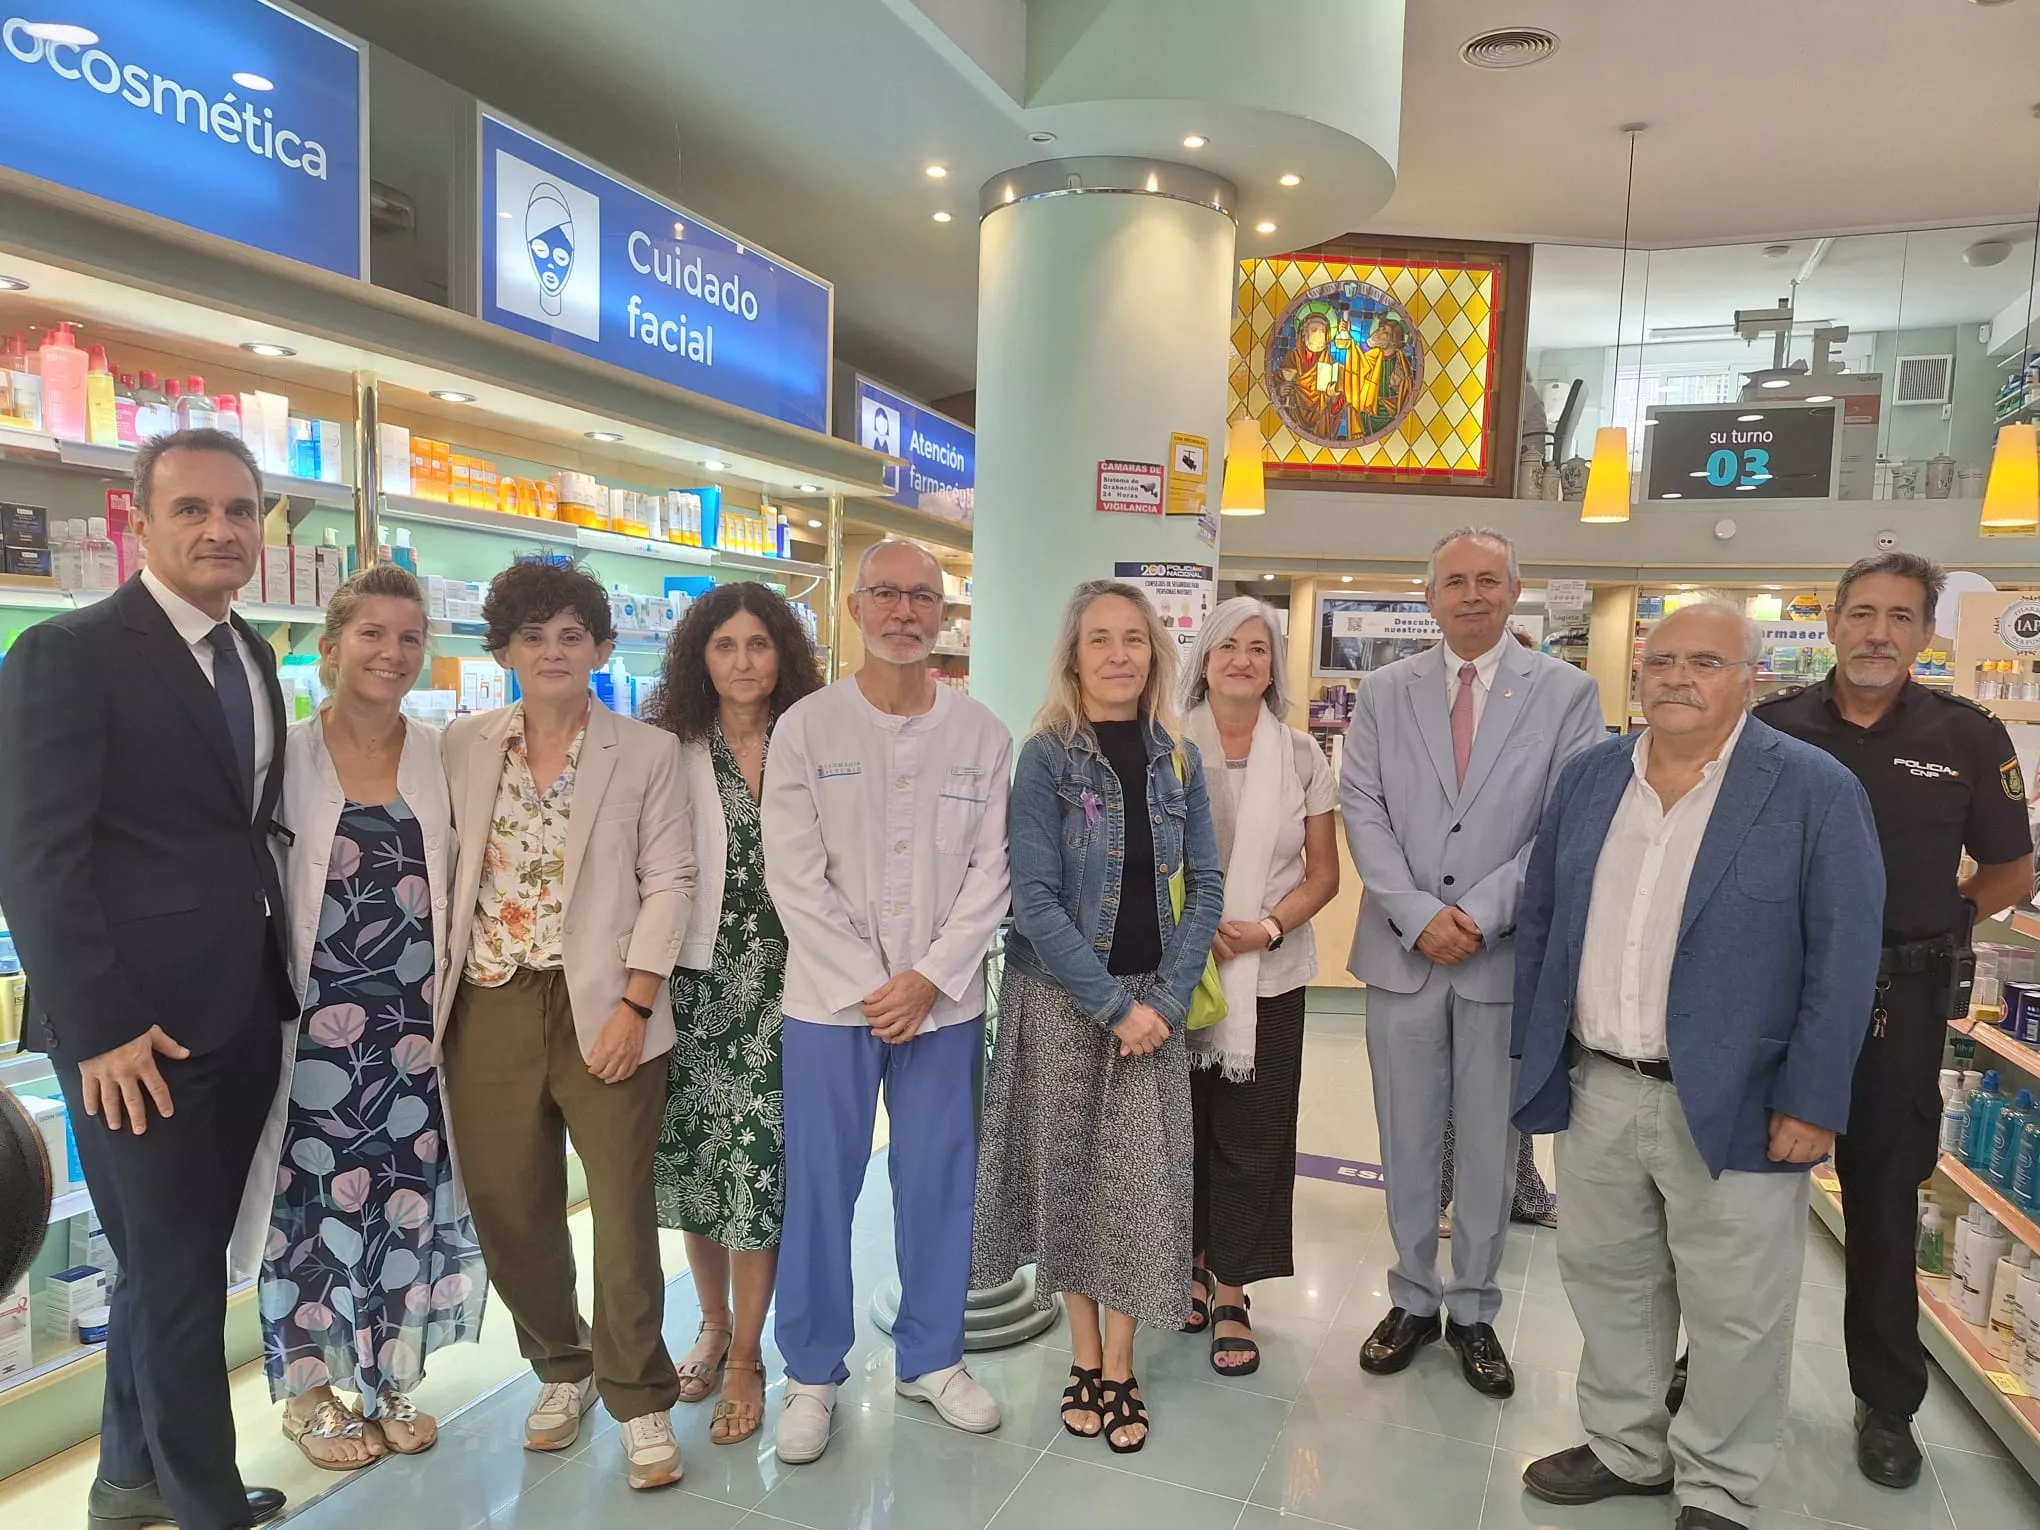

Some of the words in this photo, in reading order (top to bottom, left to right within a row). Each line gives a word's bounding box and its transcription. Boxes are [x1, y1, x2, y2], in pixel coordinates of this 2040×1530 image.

[627, 230, 758, 321] Cuidado
[627, 295, 713, 366] facial
[1709, 431, 1727, 444] su
[1731, 429, 1773, 444] turno
[909, 429, 965, 472] Atención
[1149, 466, 1162, 474] DE
[1706, 448, 1770, 487] 03
[1116, 491, 1139, 499] Horas
[1103, 502, 1158, 513] VIGILANCIA
[1166, 571, 1203, 579] NACIONAL
[1894, 758, 1952, 776] POLICIA
[1910, 768, 1939, 778] CNP
